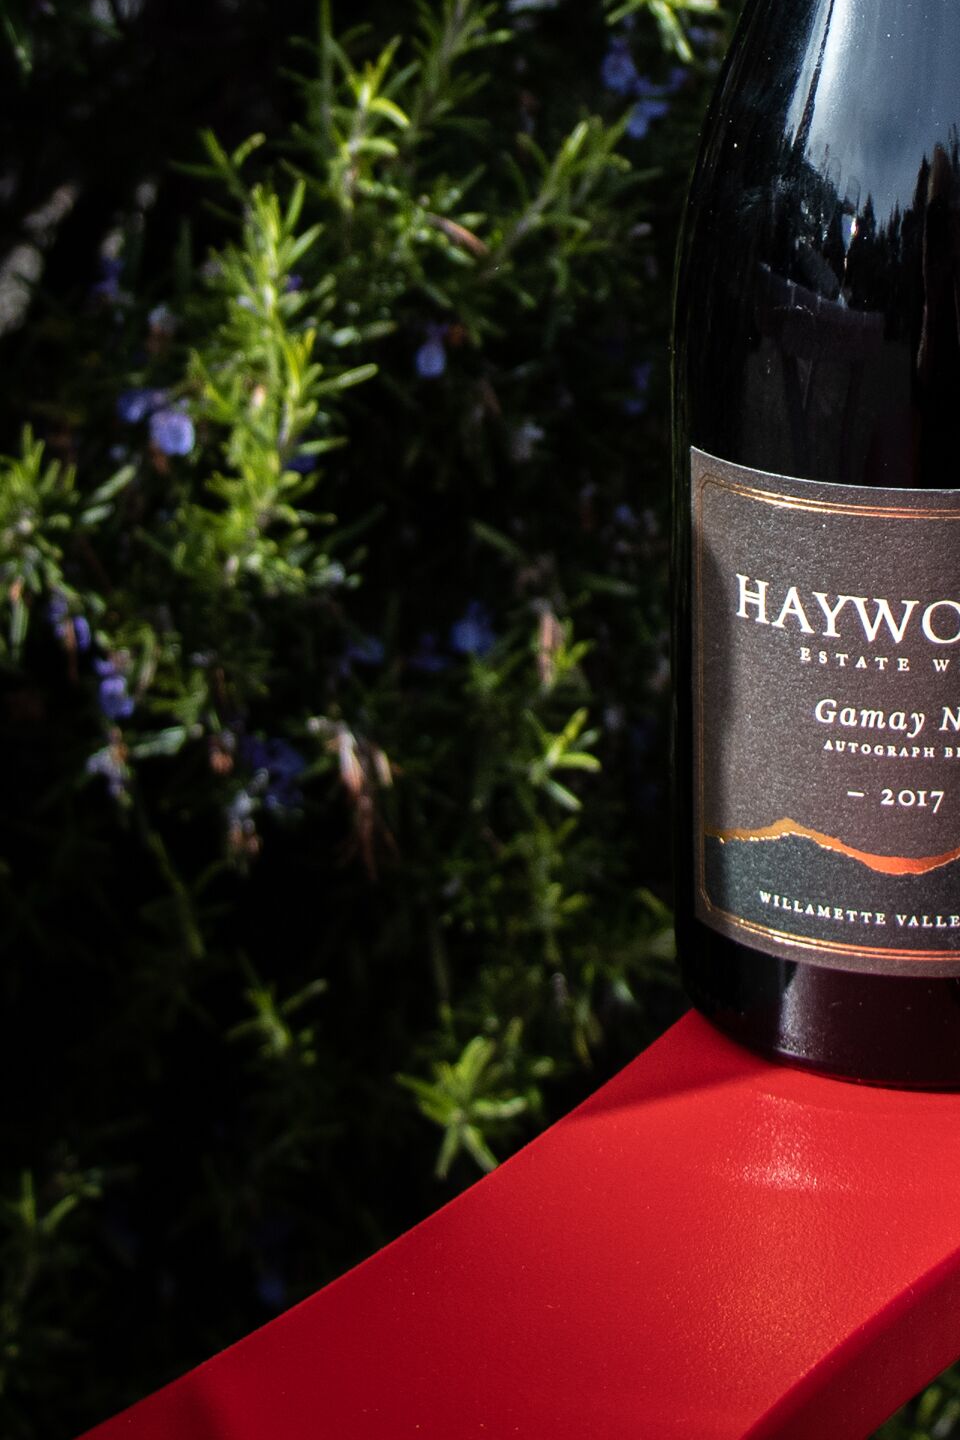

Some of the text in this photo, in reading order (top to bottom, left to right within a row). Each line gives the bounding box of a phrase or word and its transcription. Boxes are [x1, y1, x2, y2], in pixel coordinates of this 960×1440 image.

[799, 646, 911, 672] ESTATE
[813, 697, 926, 739] Gamay
[823, 738, 936, 759] AUTOGRAPH
[879, 787, 945, 815] 2017
[758, 890, 887, 926] WILLAMETTE
